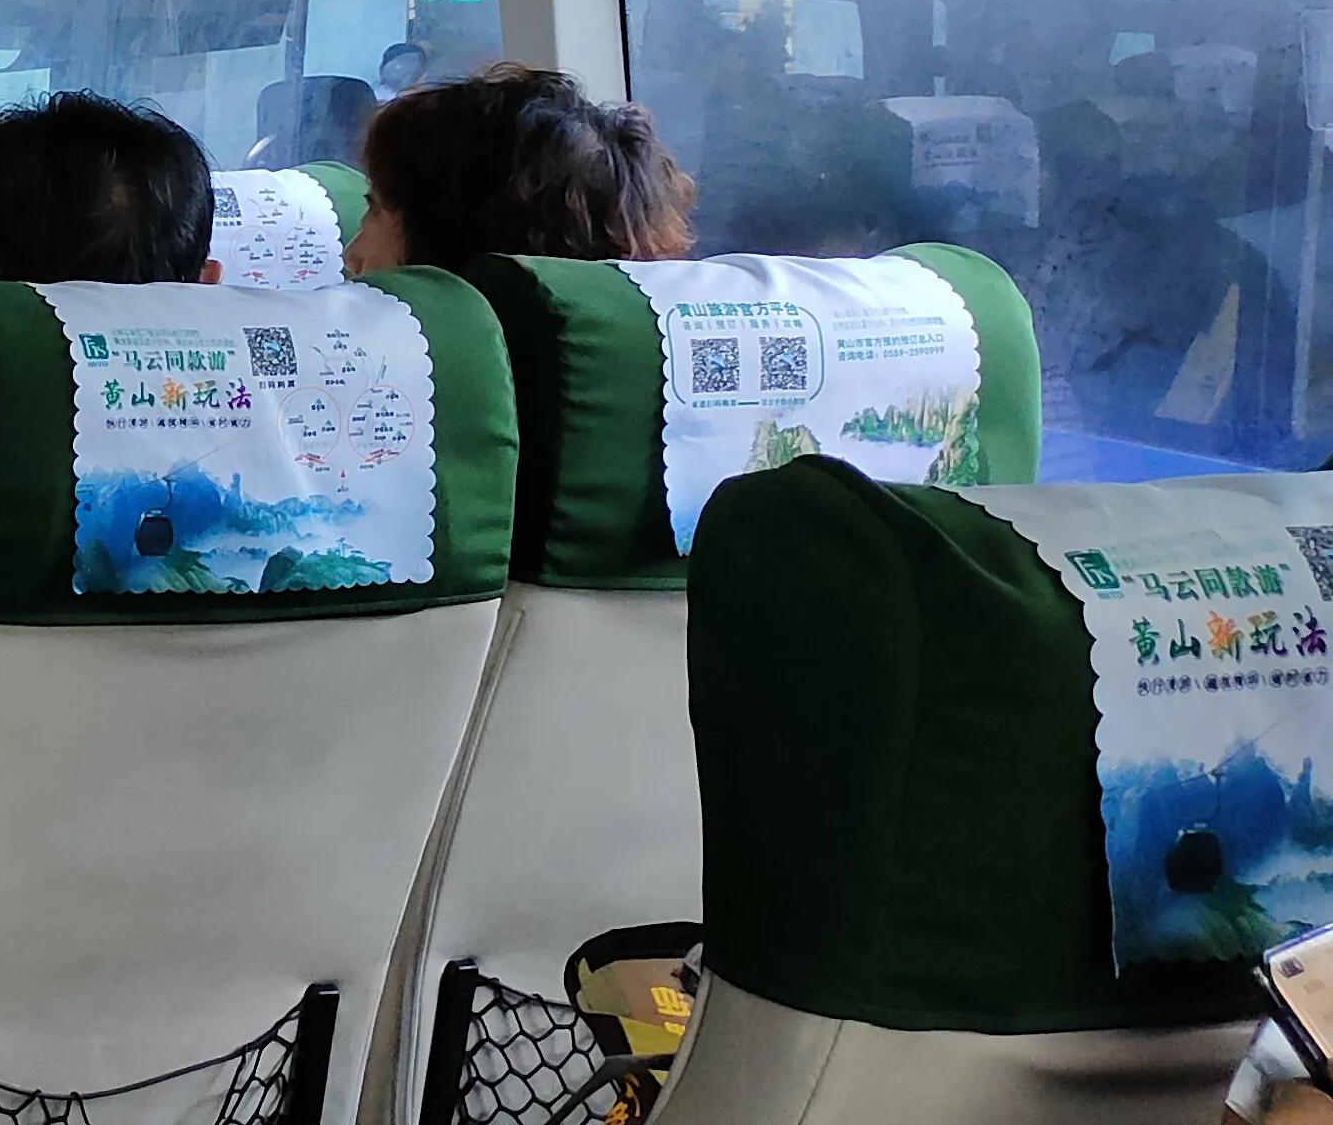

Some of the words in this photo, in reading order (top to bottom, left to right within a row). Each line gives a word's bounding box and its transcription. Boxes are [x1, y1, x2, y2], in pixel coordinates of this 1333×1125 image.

[100, 377, 252, 411] 黄山新玩法
[1128, 604, 1328, 667] 黄山新玩法
